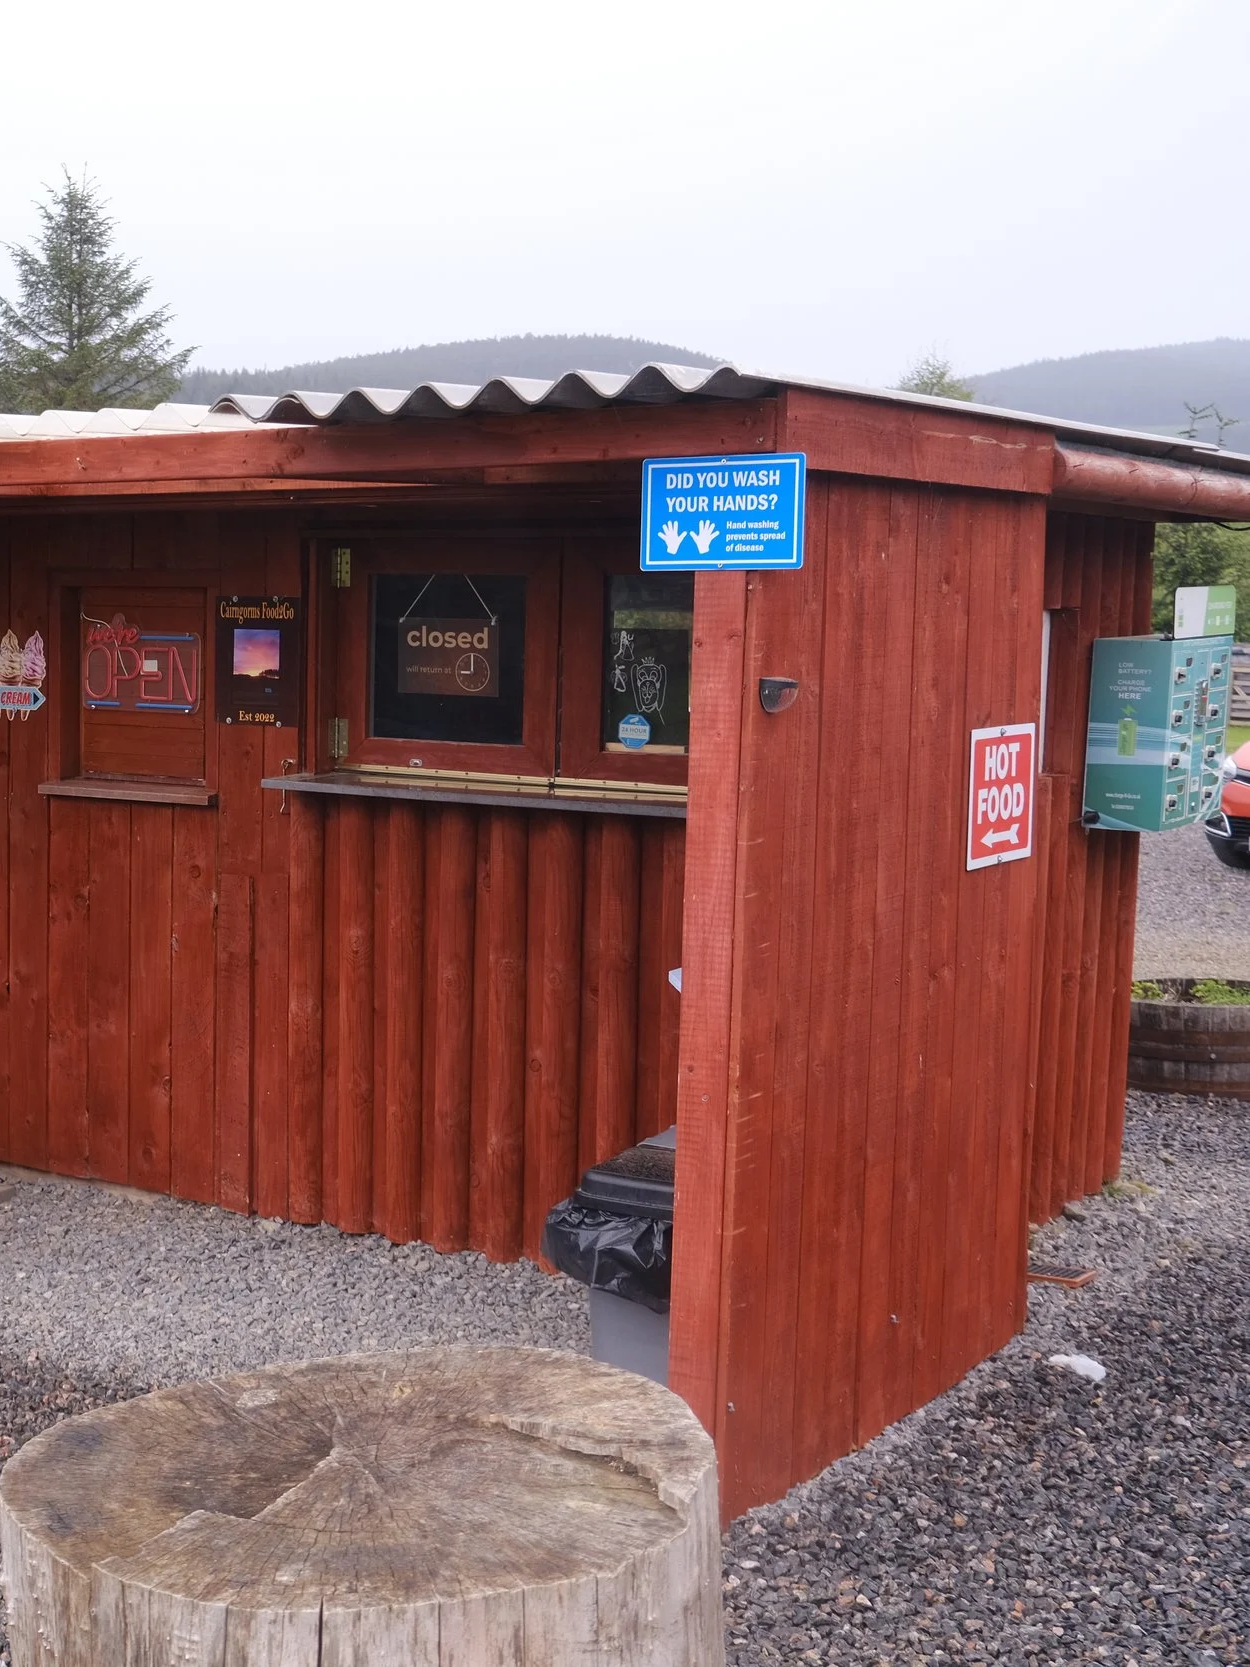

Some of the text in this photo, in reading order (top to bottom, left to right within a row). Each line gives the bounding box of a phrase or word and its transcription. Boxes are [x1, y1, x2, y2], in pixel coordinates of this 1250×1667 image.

[666, 470, 780, 490] DID YOU WASH
[666, 494, 778, 512] YOUR HANDS?
[726, 520, 779, 531] Hand washing
[726, 531, 786, 541] prevents spread
[725, 544, 764, 552] of disease
[220, 601, 260, 624] Cairngorms
[406, 625, 488, 649] closed
[85, 644, 197, 703] OPEN
[406, 664, 452, 674] will return at
[1, 692, 31, 705] CREAM
[239, 710, 275, 723] Est 2022
[630, 726, 647, 734] HOUR
[984, 742, 1020, 781] HOT
[977, 782, 1024, 824] FOOD
